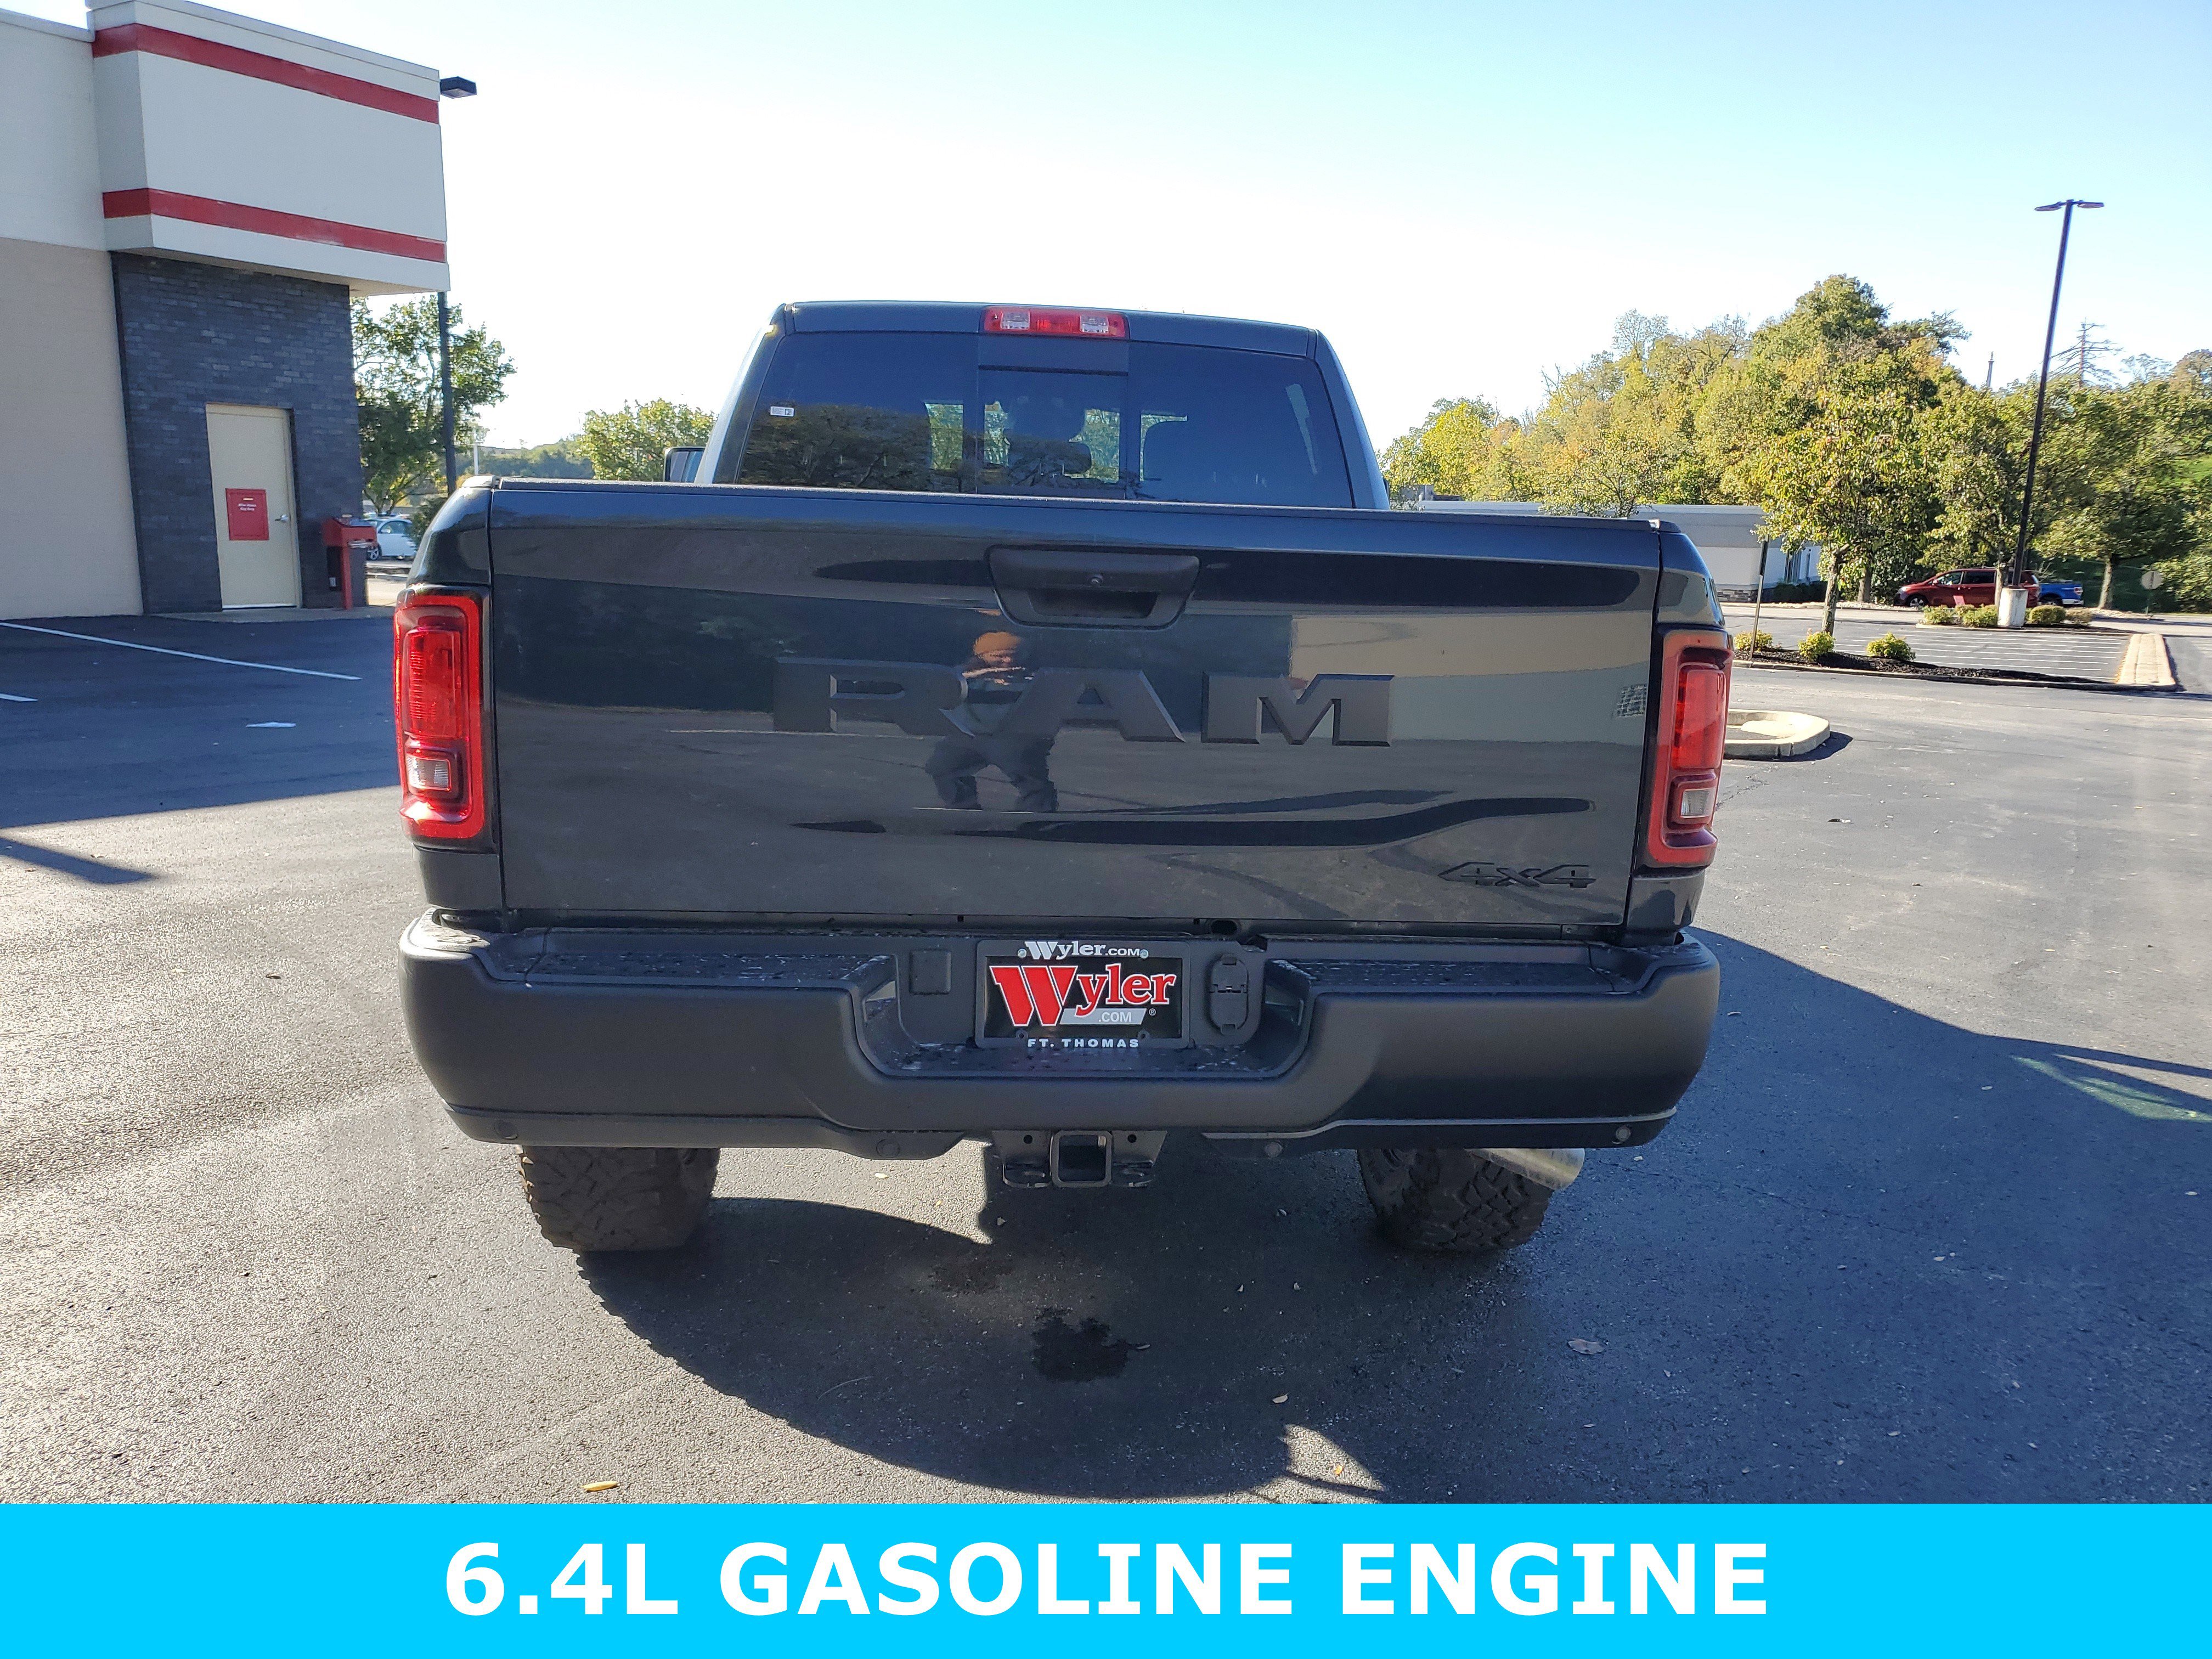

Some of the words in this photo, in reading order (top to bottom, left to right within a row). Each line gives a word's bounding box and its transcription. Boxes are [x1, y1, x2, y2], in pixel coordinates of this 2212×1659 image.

[772, 657, 1395, 747] RAM
[989, 963, 1177, 1026] Wyler
[1028, 1039, 1054, 1048] FT.
[1062, 1039, 1139, 1048] THOMAS
